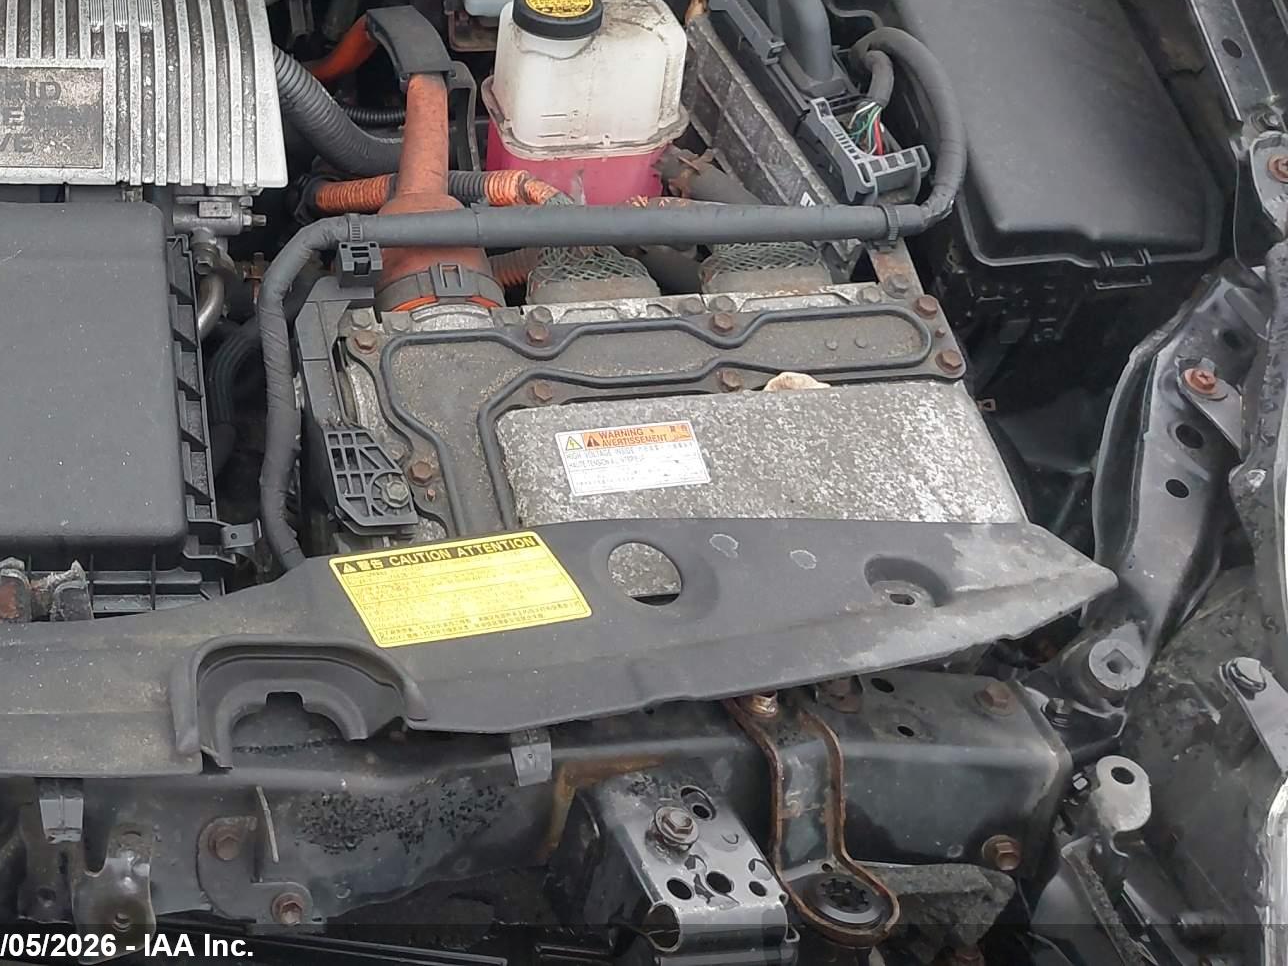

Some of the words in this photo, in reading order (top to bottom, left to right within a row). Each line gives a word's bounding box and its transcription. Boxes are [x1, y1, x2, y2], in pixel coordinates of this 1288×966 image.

[599, 428, 644, 440] WARNING
[602, 434, 668, 448] AVERTISSEMENT
[388, 548, 452, 568] CAUTION
[457, 536, 537, 558] ATTENTION
